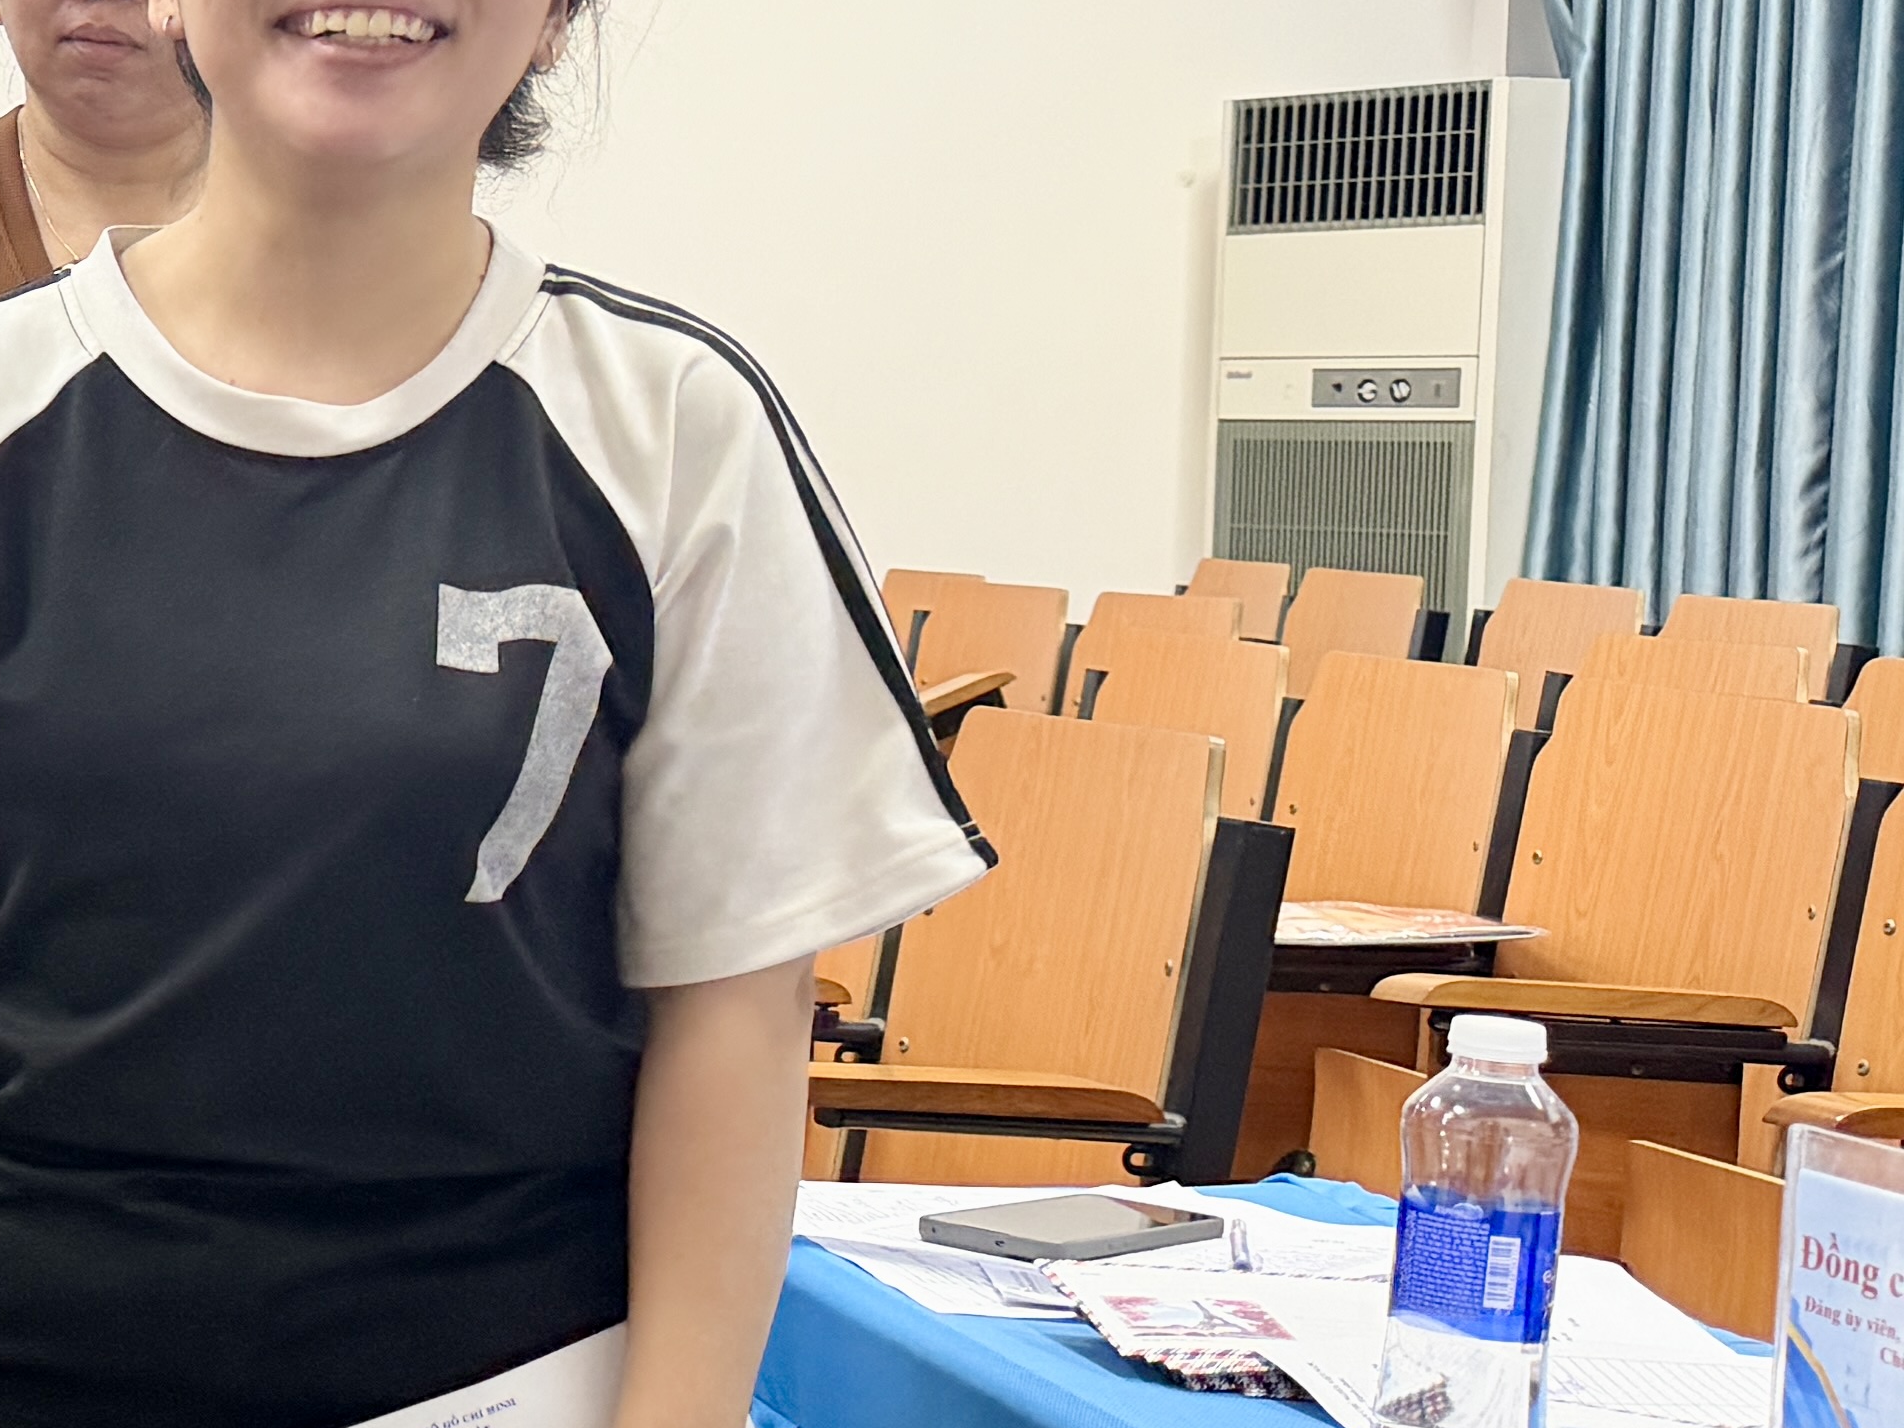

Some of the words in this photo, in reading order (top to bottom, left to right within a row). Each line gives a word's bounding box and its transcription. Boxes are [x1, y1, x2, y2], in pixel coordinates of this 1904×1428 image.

[436, 583, 613, 903] 7
[1801, 1232, 1881, 1301] Đồng
[1804, 1294, 1842, 1327] Đảng
